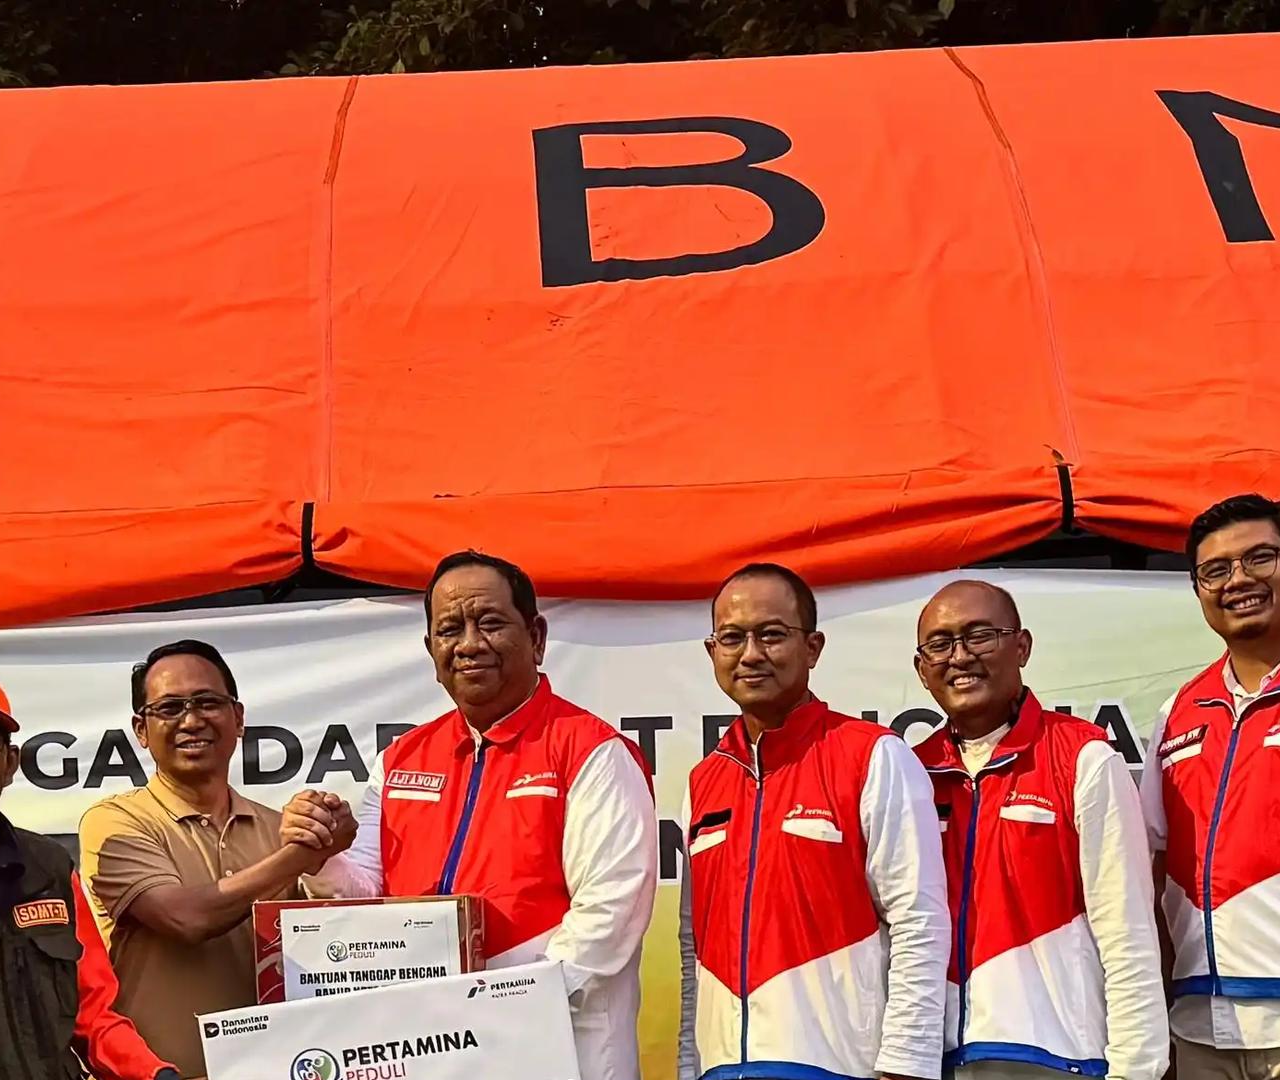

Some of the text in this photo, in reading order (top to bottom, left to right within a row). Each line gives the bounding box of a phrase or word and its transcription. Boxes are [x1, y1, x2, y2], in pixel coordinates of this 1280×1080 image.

[348, 939, 407, 951] PERTAMINA
[299, 965, 448, 985] BANTUAN TANGGAP BENCANA
[221, 1014, 269, 1028] Danantara
[222, 1023, 268, 1036] Indonesia
[342, 1029, 479, 1069] PERTAMINA
